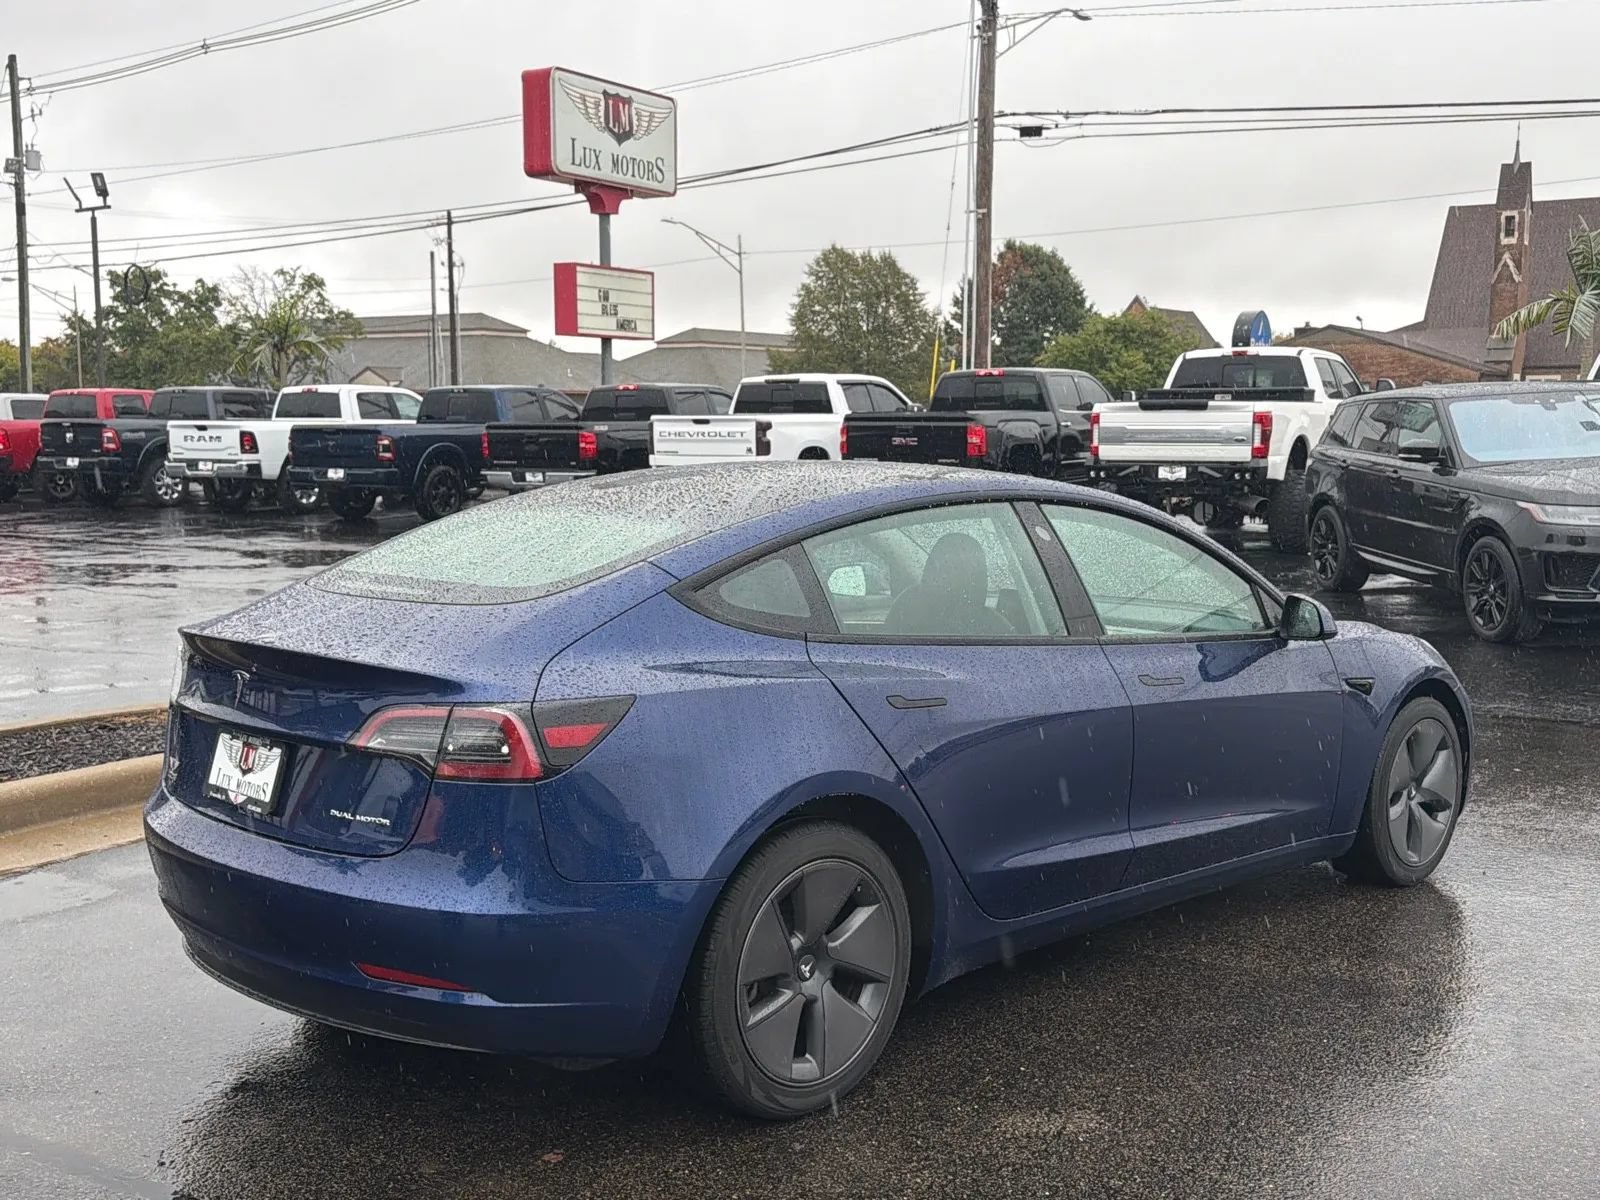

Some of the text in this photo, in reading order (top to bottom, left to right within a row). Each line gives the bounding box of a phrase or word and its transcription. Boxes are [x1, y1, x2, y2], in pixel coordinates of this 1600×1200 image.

[608, 99, 630, 134] LM
[570, 137, 665, 184] LUX MOTORS
[183, 434, 222, 443] RAM
[658, 430, 747, 439] CHEVROLET
[891, 437, 919, 446] GMC
[236, 777, 269, 801] MOTORS
[330, 809, 391, 826] DUAL MOTOR
